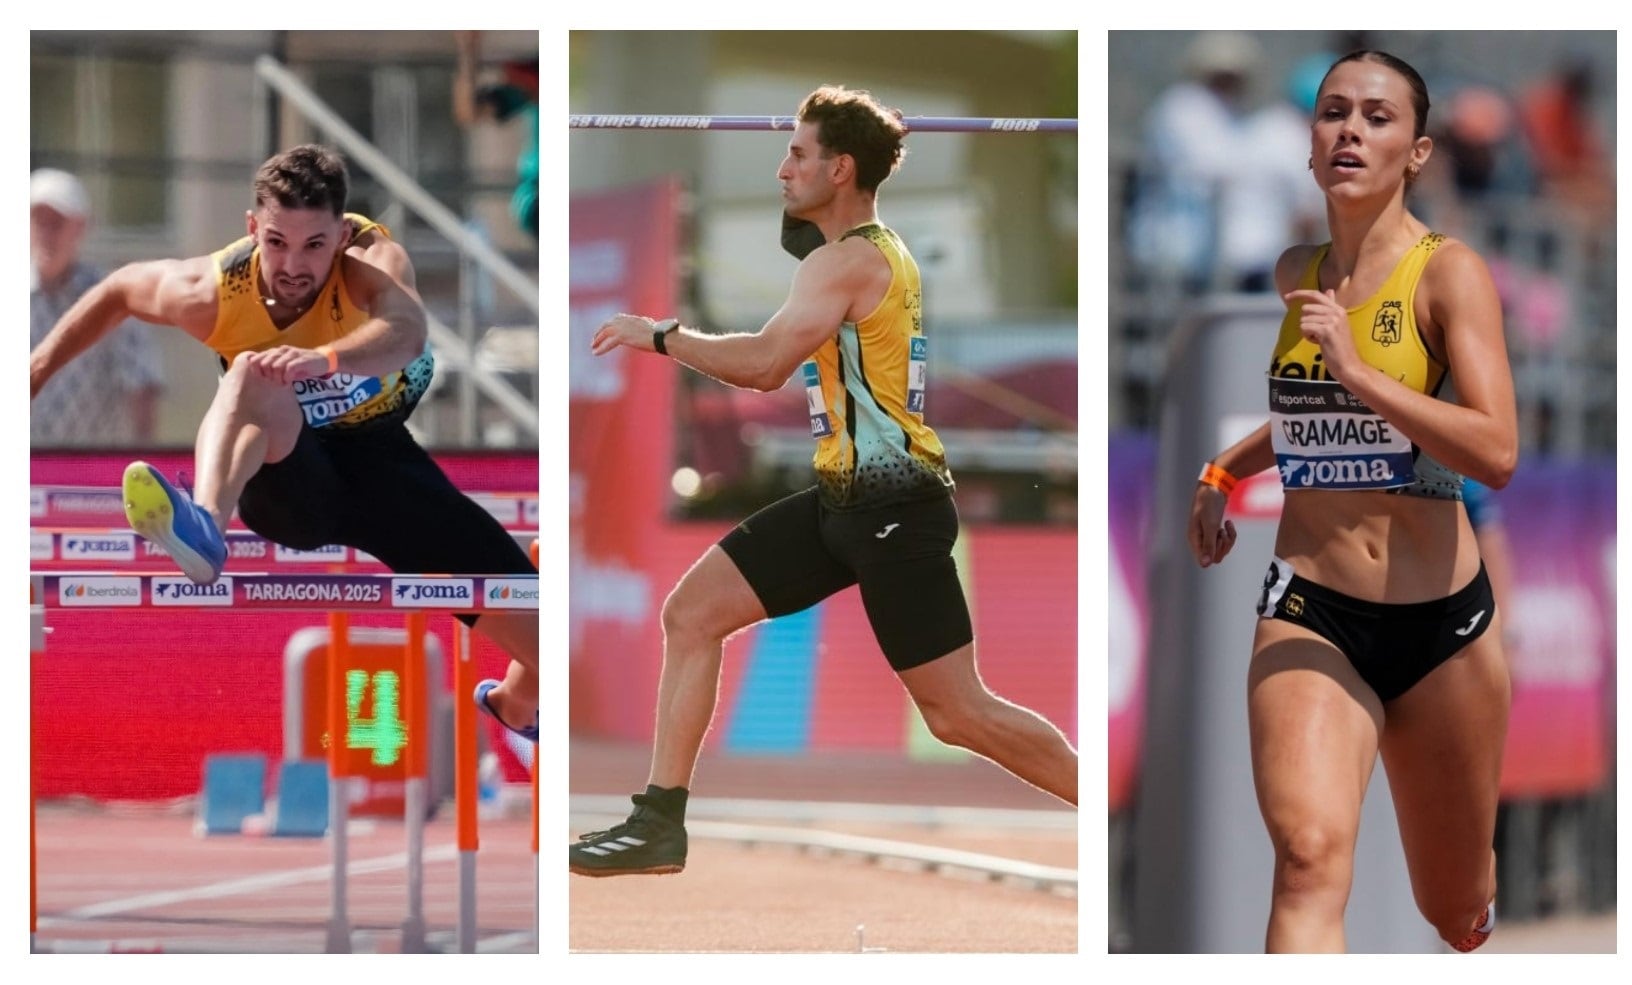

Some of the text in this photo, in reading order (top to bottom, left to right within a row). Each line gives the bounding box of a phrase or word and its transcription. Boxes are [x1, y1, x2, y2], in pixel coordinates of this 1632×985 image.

[1382, 300, 1402, 308] CAS
[1278, 394, 1327, 407] esportcat
[1282, 417, 1392, 447] GRAMAGE
[233, 541, 266, 557] 2025
[87, 585, 138, 597] Iberdrola
[243, 583, 381, 601] TARRAGONA 2025
[345, 669, 408, 766] 4
